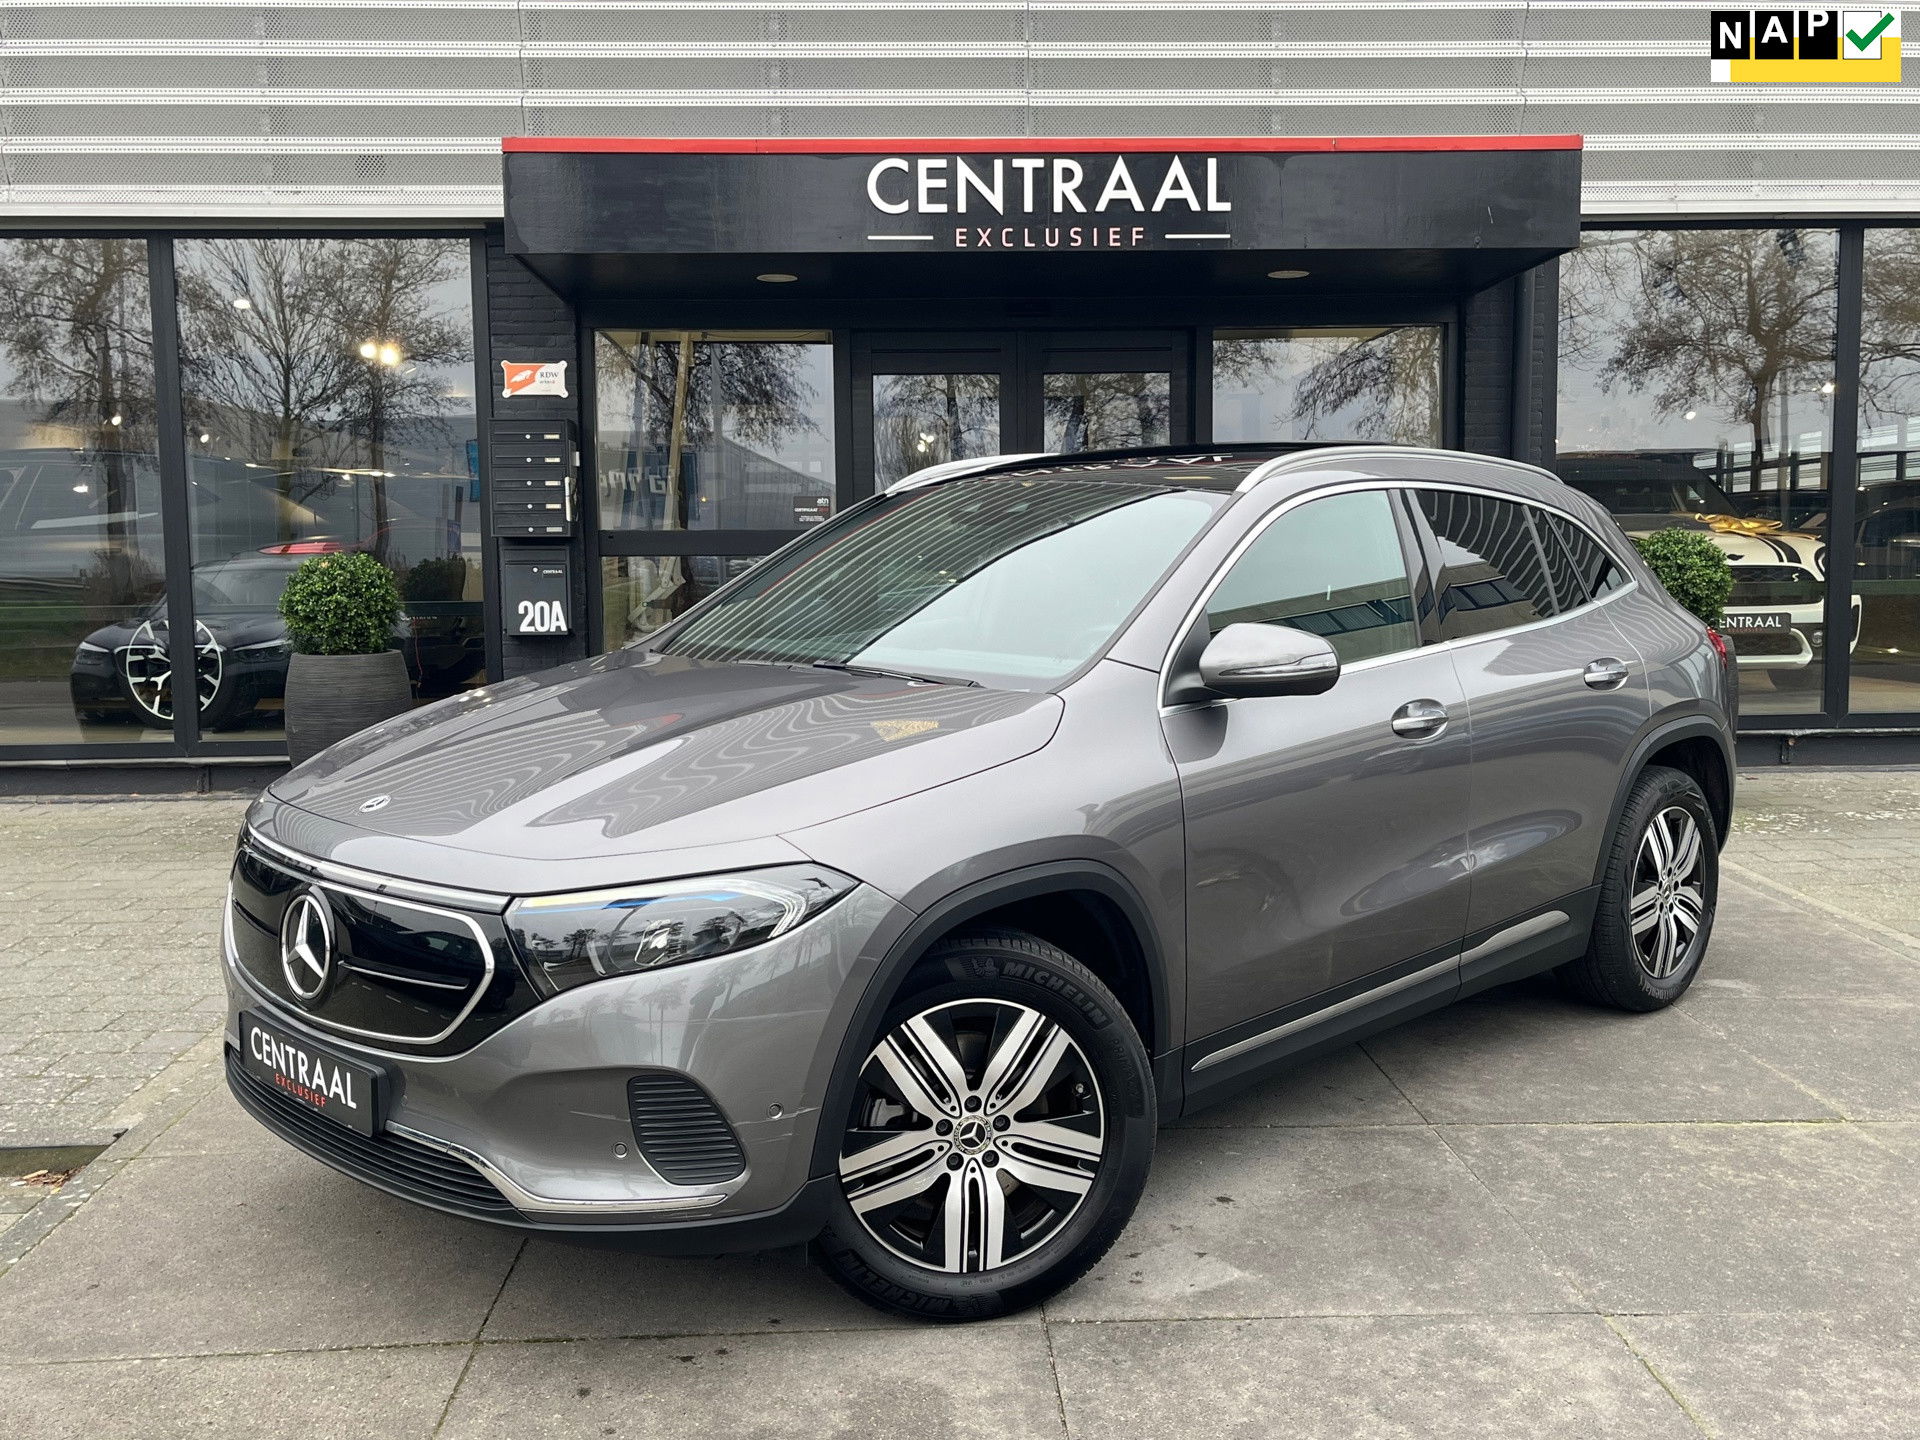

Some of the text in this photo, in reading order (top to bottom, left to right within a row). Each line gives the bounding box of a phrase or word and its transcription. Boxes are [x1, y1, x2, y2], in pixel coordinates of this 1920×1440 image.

[867, 155, 1232, 215] CENTRAAL
[955, 227, 1144, 247] EXCLUSIEF
[518, 600, 568, 632] 20A
[1719, 616, 1782, 628] ENTRAAL
[1001, 961, 1109, 1028] MICHELIN
[250, 1026, 357, 1109] CENTRAAL
[275, 1072, 326, 1108] EXCLUSIEF
